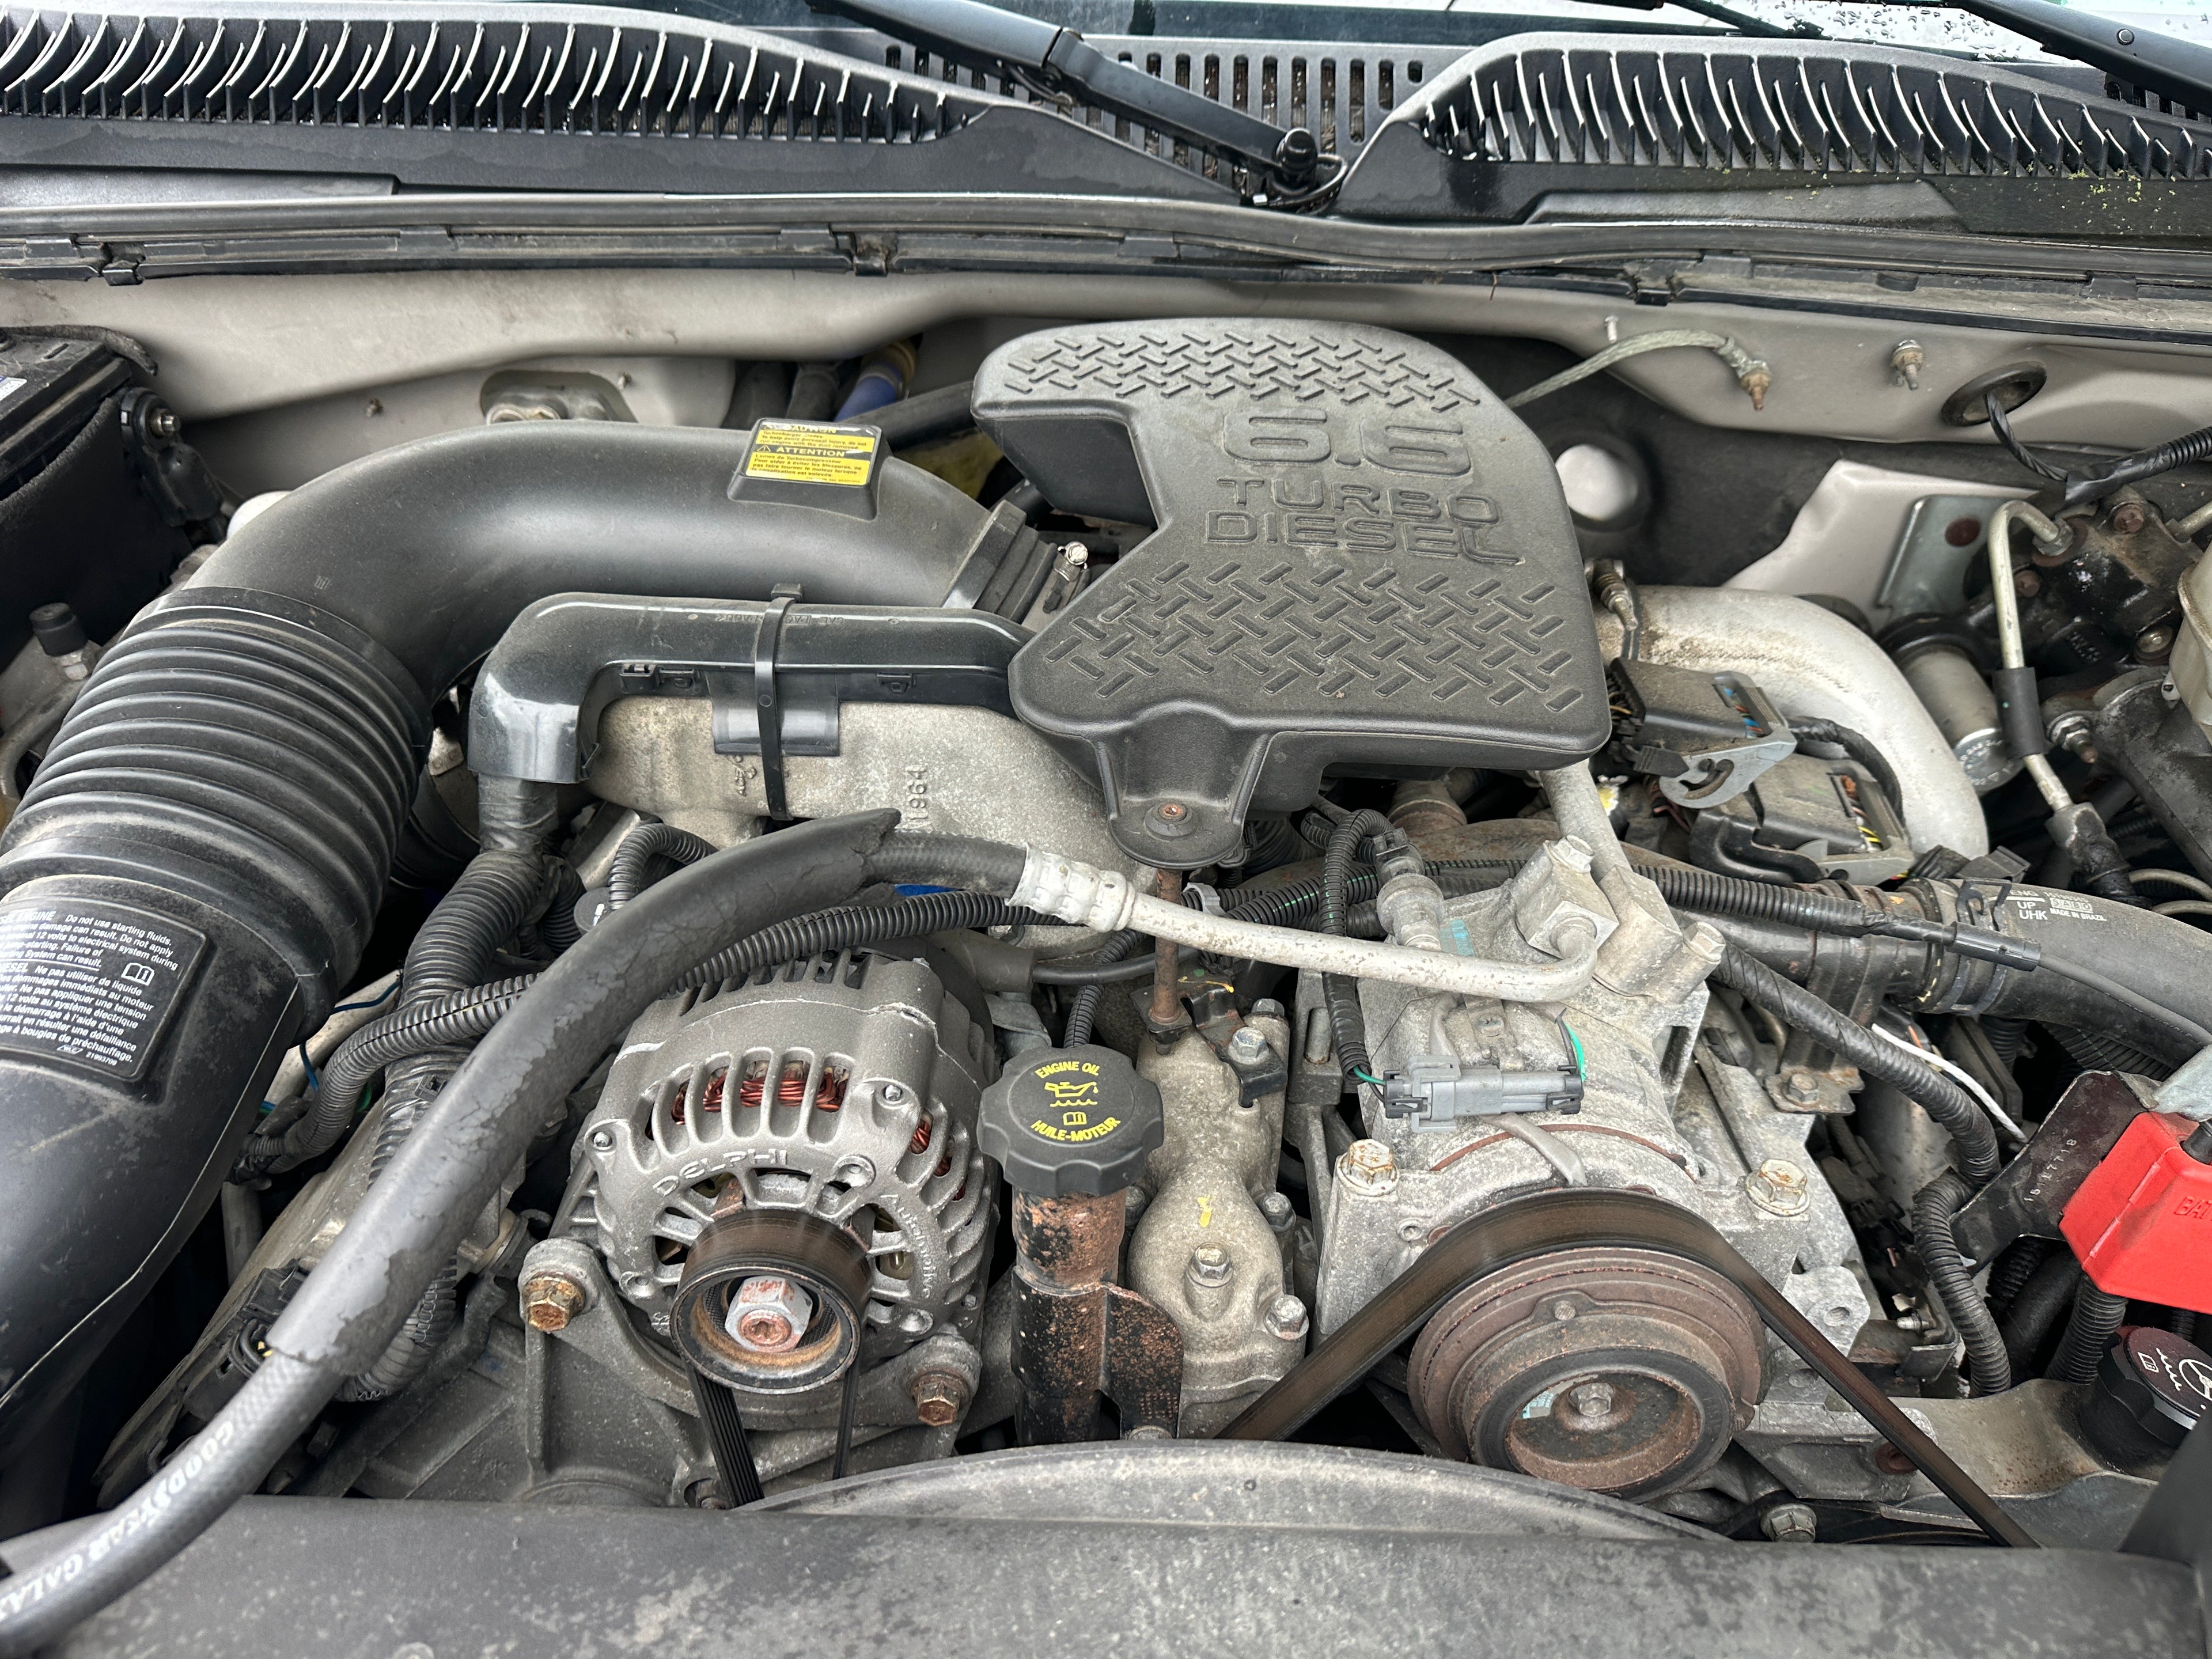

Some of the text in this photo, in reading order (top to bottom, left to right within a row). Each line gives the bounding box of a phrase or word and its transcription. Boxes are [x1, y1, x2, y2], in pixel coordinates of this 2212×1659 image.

[777, 446, 844, 457] ATTENTION
[1224, 408, 1472, 477] 6.6
[1216, 477, 1499, 524] TURBO
[1207, 510, 1521, 566] DIESEL
[2017, 901, 2036, 910] UP
[2019, 910, 2048, 921] UHK
[2050, 908, 2071, 917] MADE
[2080, 912, 2107, 921] BRAZIL
[39, 922, 72, 932] damage
[73, 926, 90, 934] can
[90, 929, 117, 940] result.
[119, 933, 132, 943] Do
[133, 938, 149, 948] not
[149, 944, 173, 958] apply
[65, 914, 172, 946] Do not use starting fluids.
[25, 949, 56, 960] System
[56, 953, 74, 962] can
[74, 956, 102, 968] result.
[47, 933, 67, 941] volts
[68, 934, 77, 942] to
[78, 936, 119, 950] electrical
[118, 945, 150, 960] system
[151, 955, 178, 971] during
[60, 942, 91, 955] Failure
[92, 949, 104, 957] of
[12, 974, 60, 986] dommages
[60, 979, 108, 997] immédiats
[108, 991, 122, 1001] au
[122, 995, 154, 1012] moteur
[34, 965, 48, 975] Ne
[47, 968, 66, 977] pas
[66, 970, 99, 983] utiliser
[98, 978, 111, 987] de
[112, 980, 142, 997] liquide
[3, 1003, 124, 1036] le démarrage à l'aide d'une
[6, 993, 18, 1002] 12
[18, 995, 40, 1005] volts
[40, 998, 54, 1007] au
[54, 1001, 93, 1015] système
[93, 1008, 139, 1028] électrique
[19, 983, 33, 993] Ne
[32, 987, 51, 995] pas
[51, 989, 95, 1004] appliquer
[95, 999, 113, 1009] une
[114, 1003, 147, 1021] tension
[21, 1026, 58, 1041] bougies
[58, 1033, 71, 1043] de
[71, 1037, 132, 1063] préchauffage.
[23, 1017, 35, 1025] en
[35, 1018, 71, 1032] résulter
[71, 1026, 89, 1036] une
[89, 1031, 137, 1052] défaillance
[1035, 1061, 1100, 1078] ENGINE OIL
[1031, 1117, 1121, 1141] HUILE-MOTEUR
[653, 1149, 787, 1196] DELPHI
[0, 1553, 82, 1621] GALA
